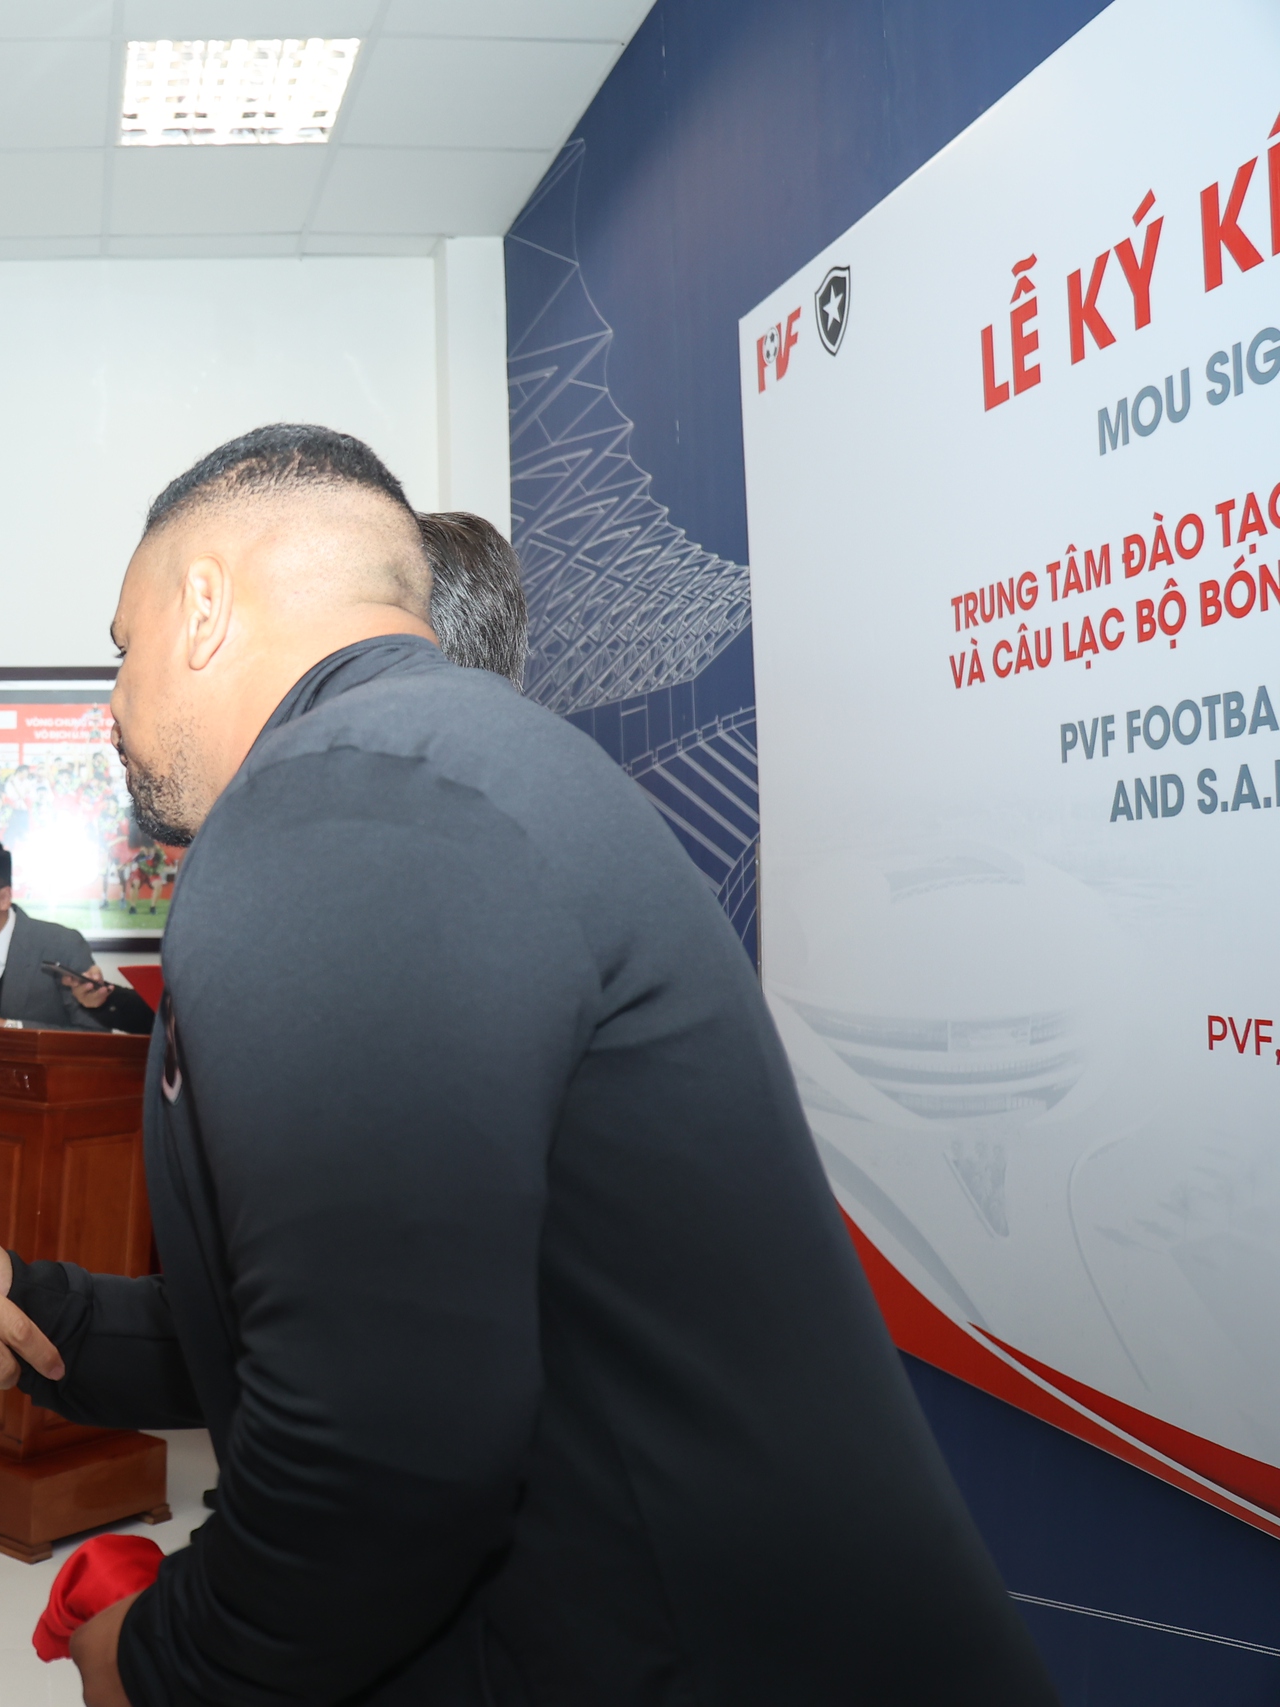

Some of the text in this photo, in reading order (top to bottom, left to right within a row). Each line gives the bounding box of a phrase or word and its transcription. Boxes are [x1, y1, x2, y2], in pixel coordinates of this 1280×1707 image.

[980, 253, 1041, 412] LỄ
[1066, 188, 1164, 366] KÝ
[1097, 366, 1191, 457] MOU
[951, 570, 1039, 632] TRUNG
[1046, 543, 1111, 602] TÂM
[1122, 512, 1205, 579] ĐÀO
[949, 637, 986, 689] VÀ
[992, 622, 1052, 679] CÂU
[1062, 607, 1125, 670] LẠC
[1136, 577, 1187, 650] BỘ
[1060, 685, 1280, 764] PVF FOOTBA
[1109, 773, 1185, 823] AND
